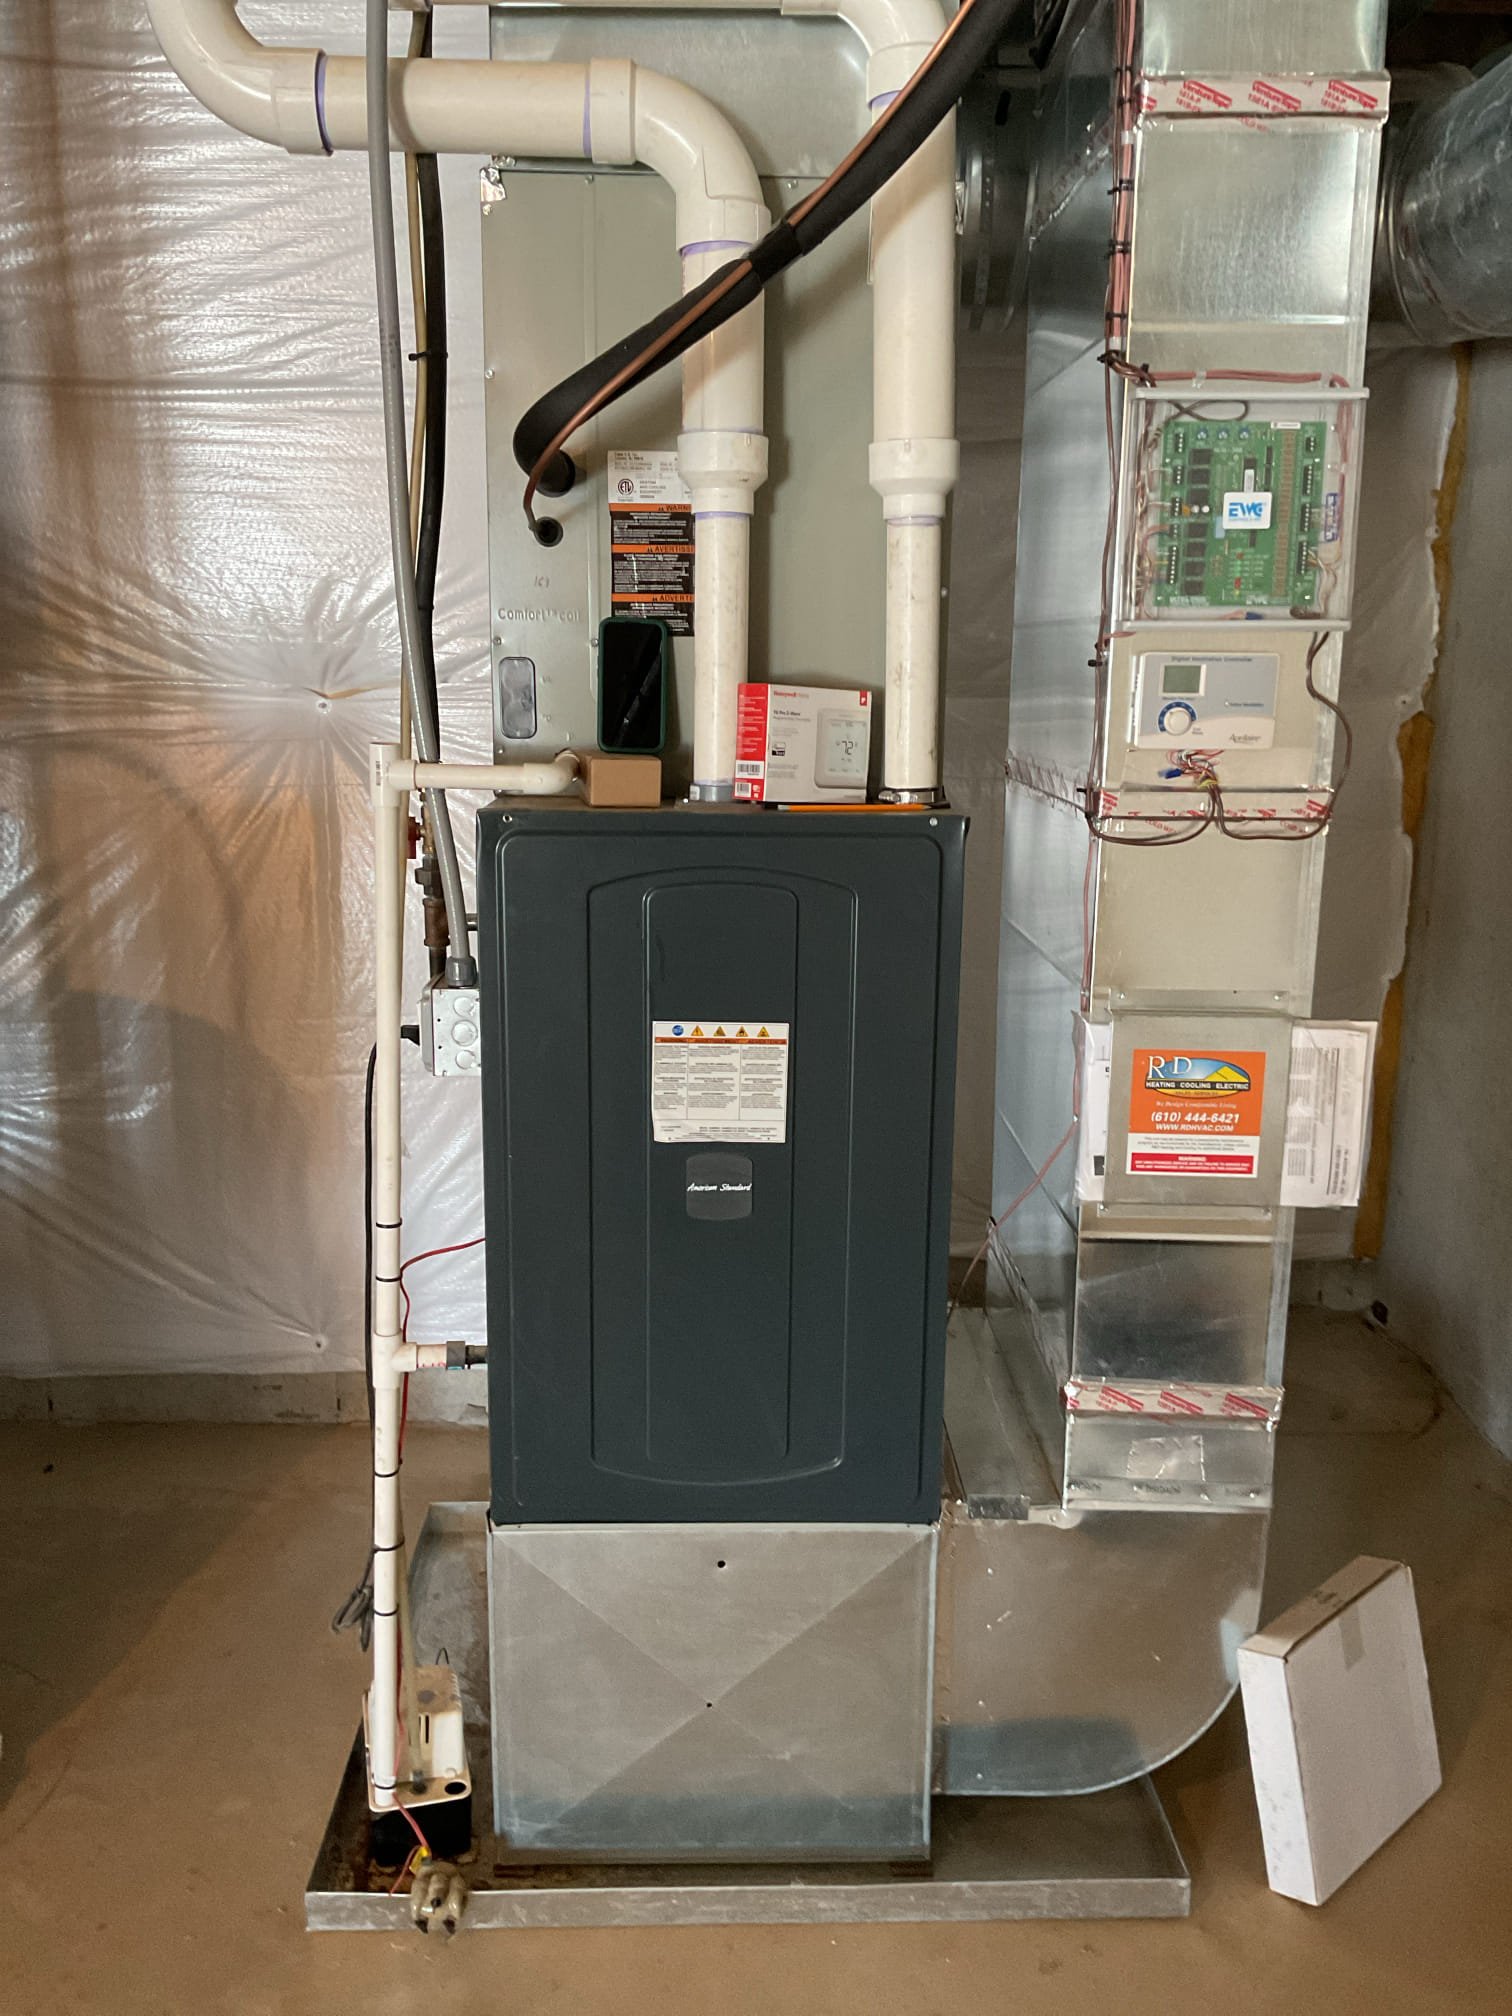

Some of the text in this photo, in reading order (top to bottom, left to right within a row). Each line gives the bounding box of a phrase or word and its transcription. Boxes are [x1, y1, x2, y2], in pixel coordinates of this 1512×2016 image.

[841, 740, 854, 756] 72
[1145, 1081, 1249, 1090] HEATING COOLING ELECTRIC
[1151, 1111, 1240, 1124] (610) 444-6421
[1155, 1123, 1234, 1132] WWW.RDHVAC.COM
[687, 1182, 752, 1192] American Standard
